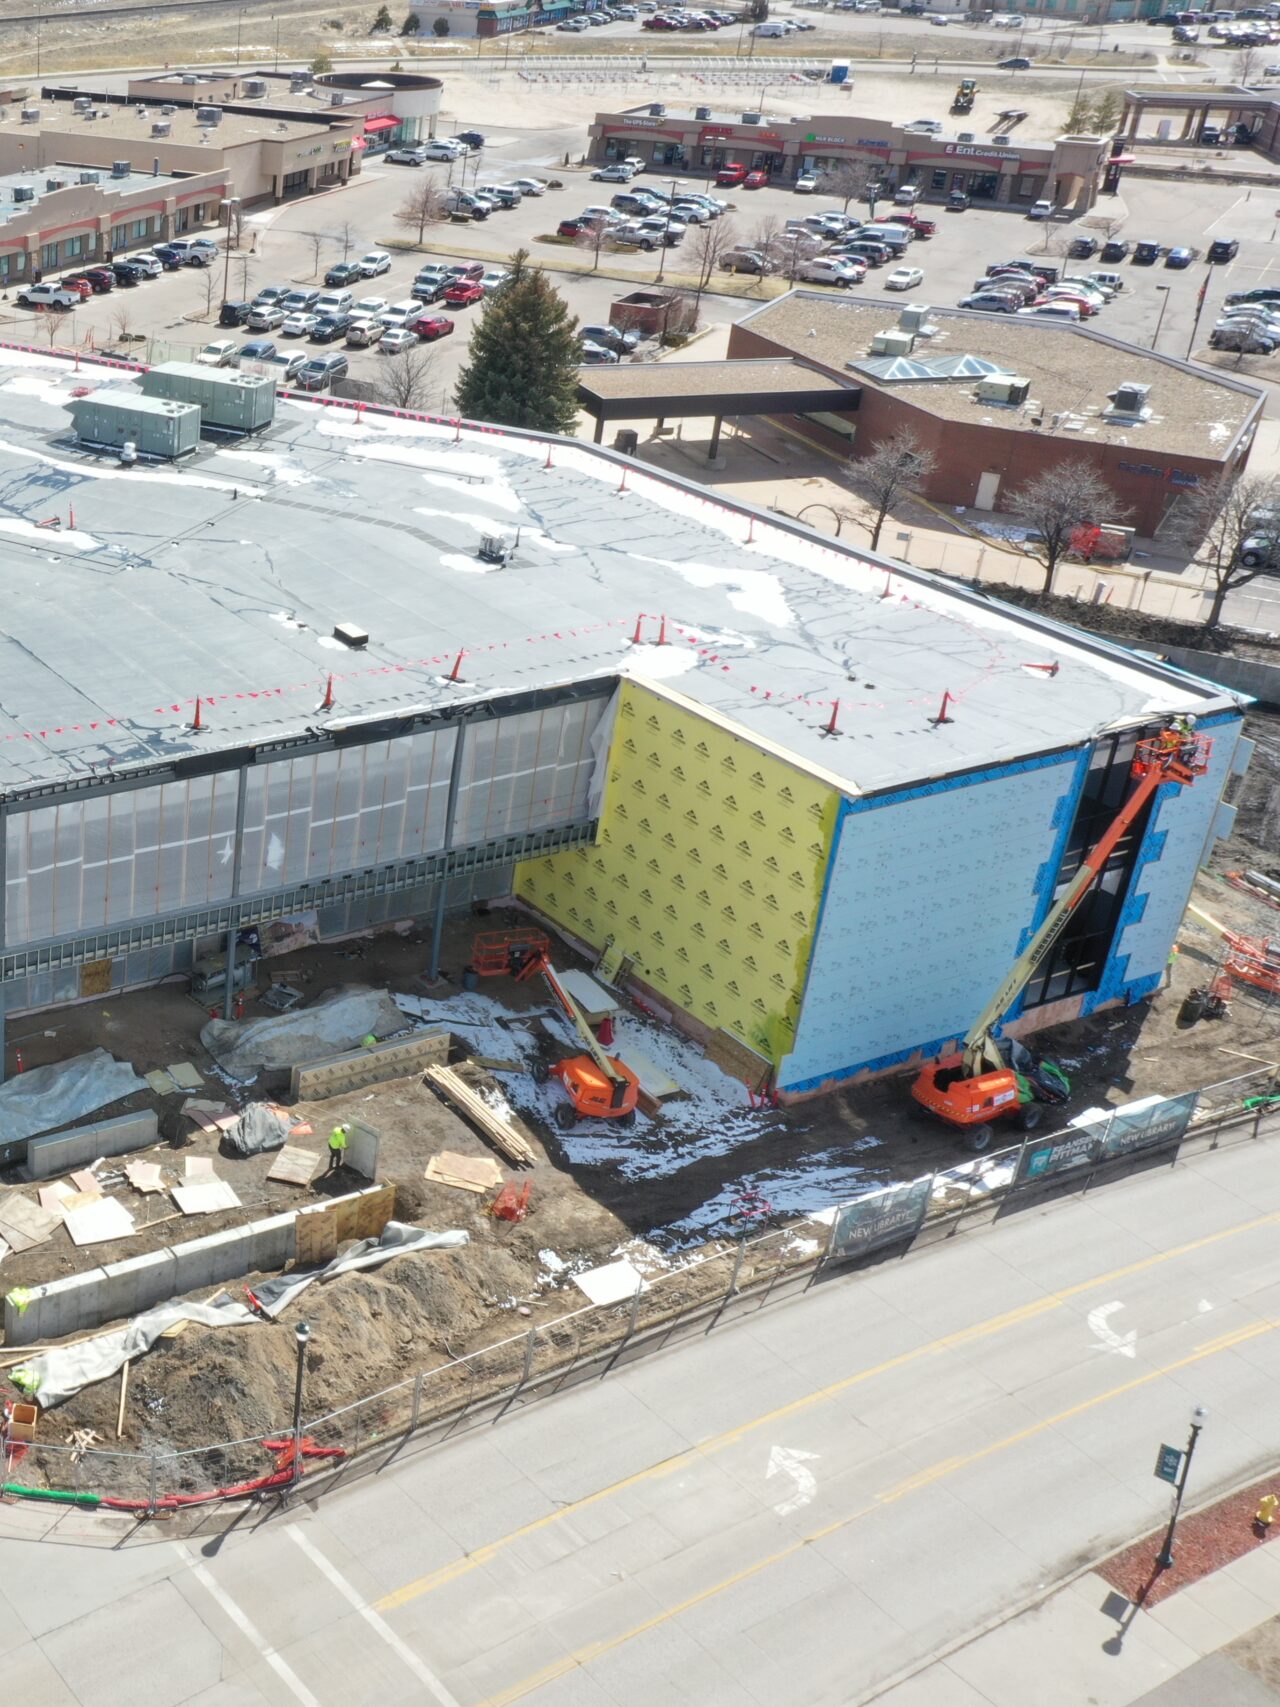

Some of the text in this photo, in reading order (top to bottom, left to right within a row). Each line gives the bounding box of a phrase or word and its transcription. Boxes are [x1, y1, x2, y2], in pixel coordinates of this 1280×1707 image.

[956, 145, 1020, 159] Ent Credit Union
[1120, 1131, 1140, 1145] NEW
[849, 1226, 871, 1239] NEW
